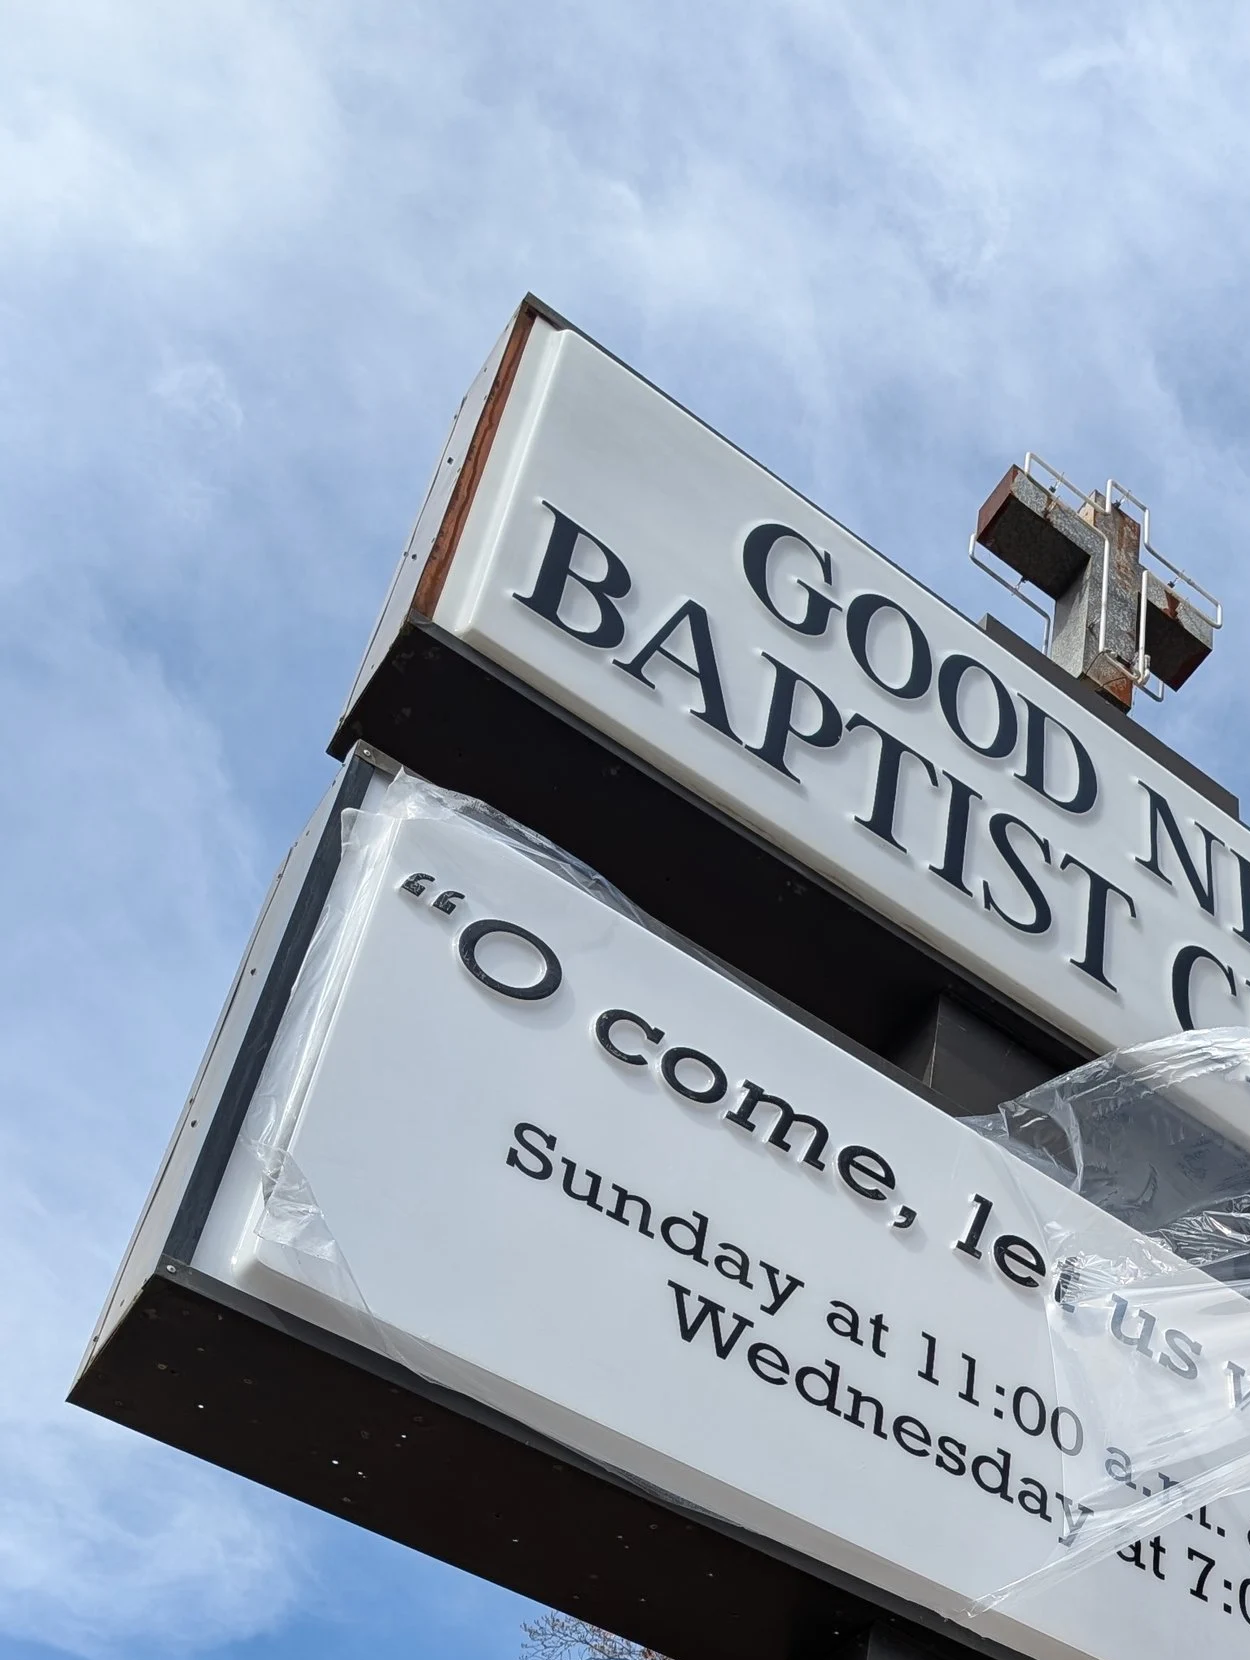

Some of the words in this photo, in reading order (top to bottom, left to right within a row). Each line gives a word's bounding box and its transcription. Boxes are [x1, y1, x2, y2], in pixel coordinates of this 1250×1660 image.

[512, 500, 1136, 993] BAPTIST
[743, 523, 1099, 814] GOOD
[506, 1122, 805, 1316] Sunday
[826, 1300, 888, 1358] at
[918, 1331, 1084, 1457] 11:00
[595, 1009, 917, 1229] come,
[1110, 1292, 1203, 1380] us
[667, 1280, 1095, 1548] Wednesday
[1116, 1535, 1166, 1581] at
